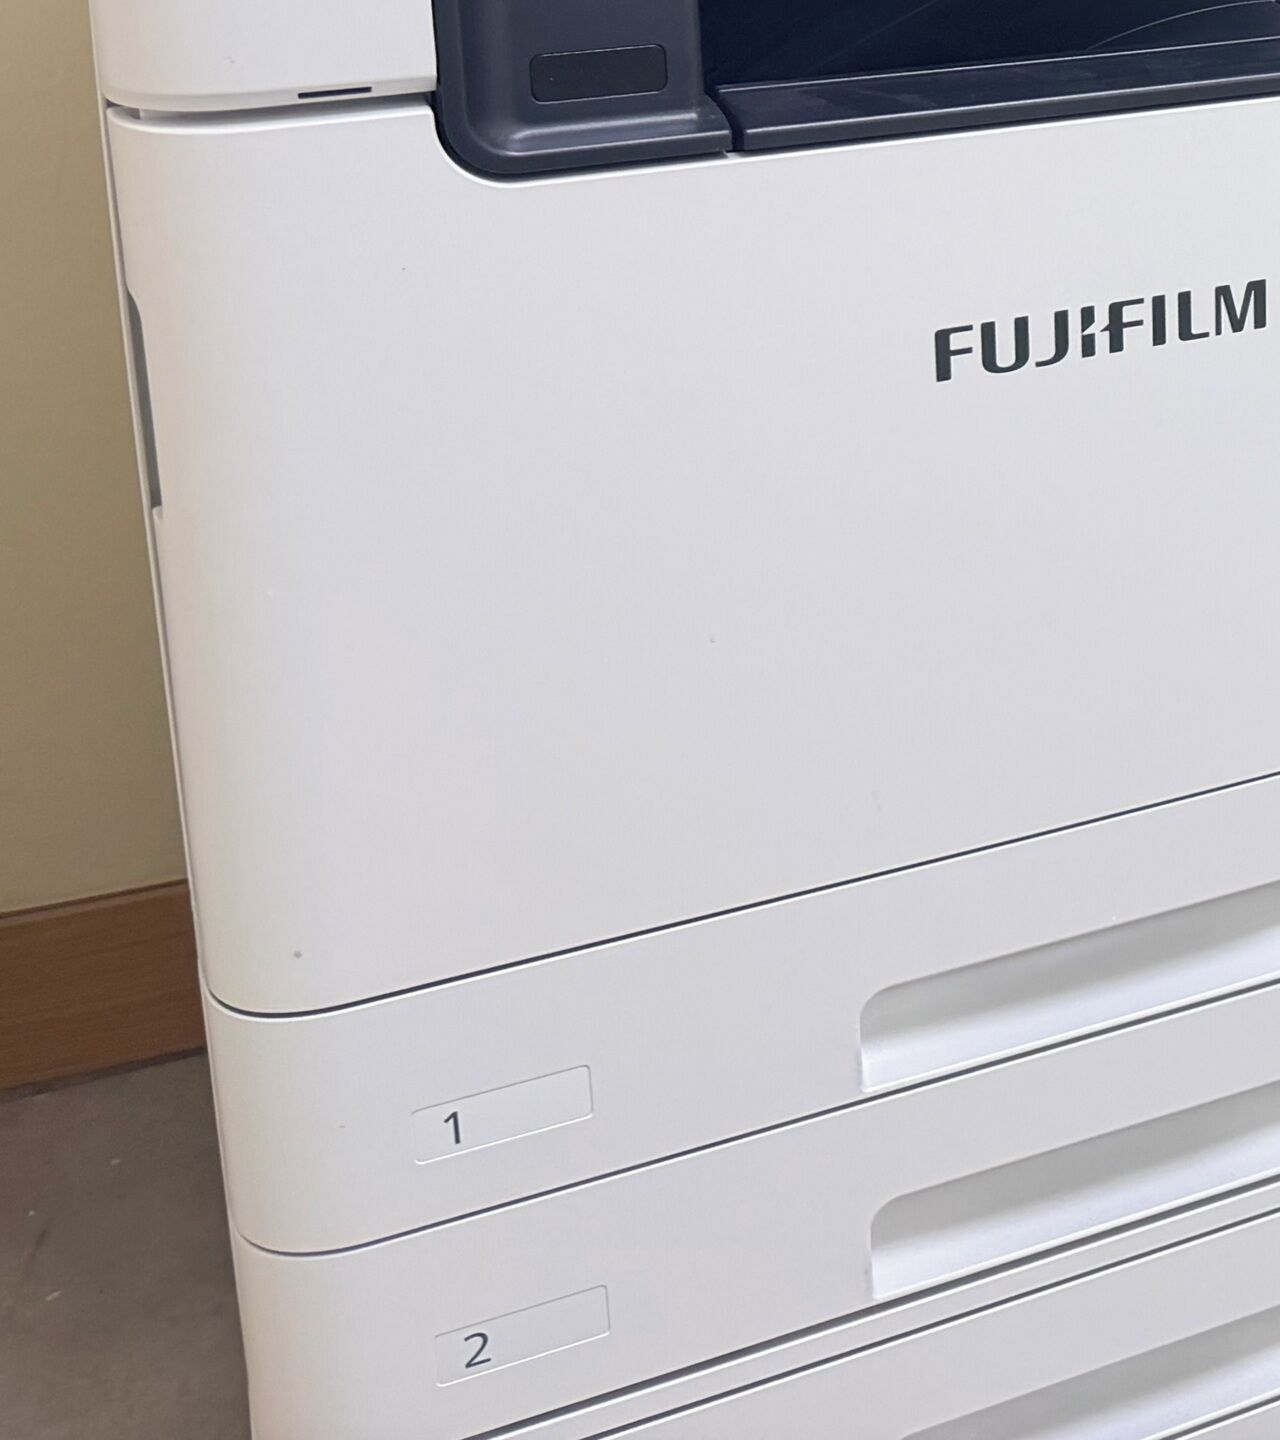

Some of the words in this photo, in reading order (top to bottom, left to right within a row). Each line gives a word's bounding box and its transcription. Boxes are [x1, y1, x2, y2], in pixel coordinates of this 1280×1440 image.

[934, 278, 1267, 383] FUJIFILM
[443, 1111, 461, 1145] 1
[463, 1332, 492, 1369] 2
